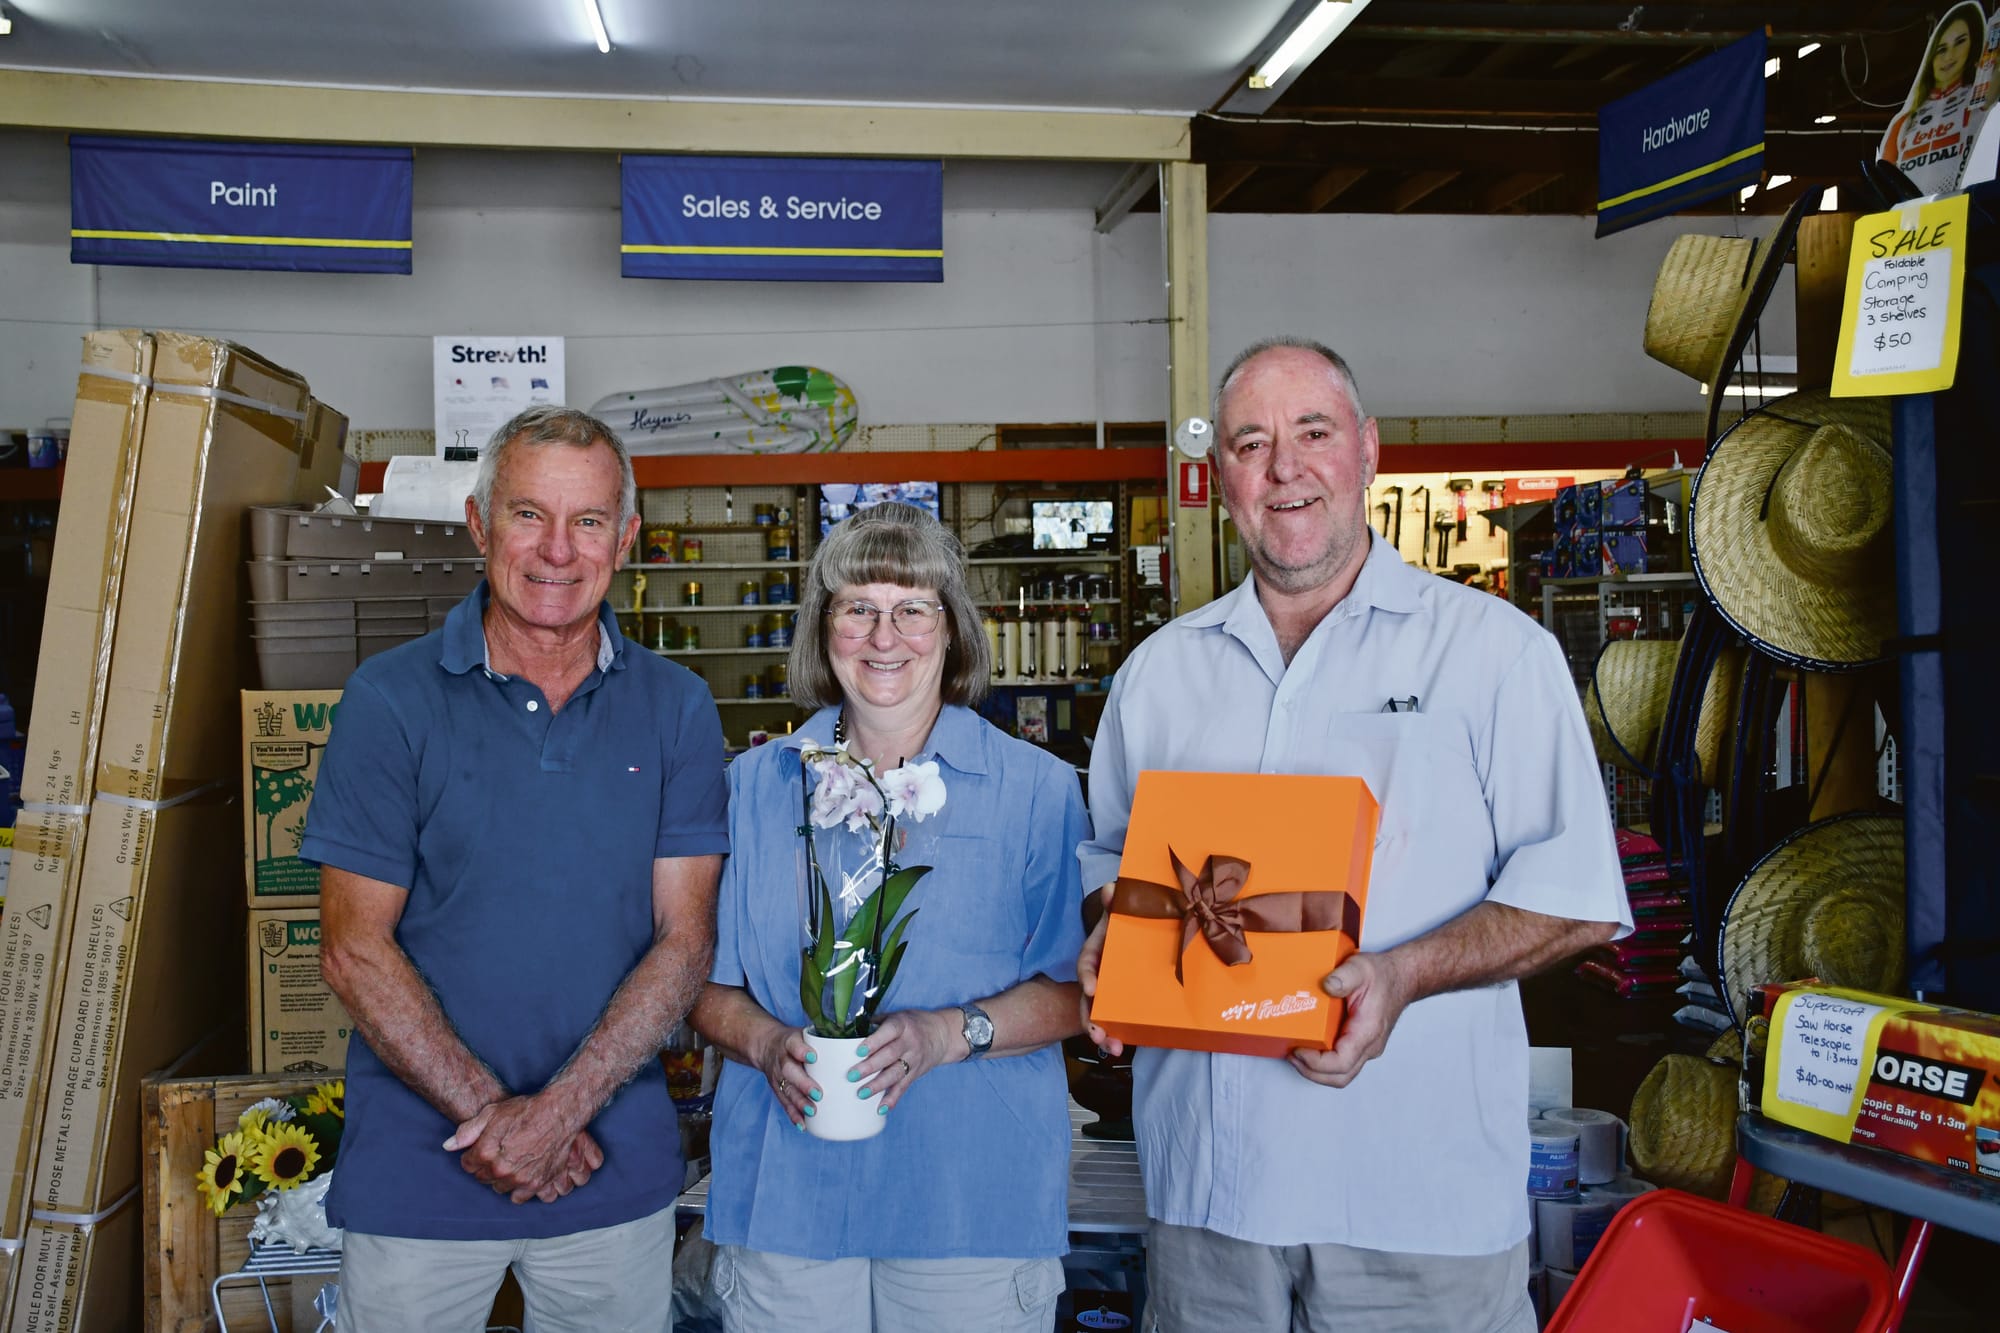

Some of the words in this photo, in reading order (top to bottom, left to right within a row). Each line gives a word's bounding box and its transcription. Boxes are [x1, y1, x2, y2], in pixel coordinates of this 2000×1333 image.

[1642, 107, 1711, 154] Hardware
[1900, 145, 1959, 173] SOUDAL
[210, 181, 278, 207] Paint
[682, 194, 750, 219] Sales
[759, 195, 779, 219] &
[786, 196, 882, 220] Service
[1869, 221, 1952, 259] SALE
[1884, 256, 1926, 270] Foldable
[1865, 271, 1929, 291] Camping
[1863, 294, 1916, 311] Storage
[1867, 314, 1876, 326] 3
[451, 345, 546, 363] Strewth!
[1873, 332, 1912, 351] $50
[70, 710, 81, 726] LH
[151, 704, 163, 719] LH
[48, 749, 61, 770] Kgs
[131, 743, 144, 764] Kgs
[46, 775, 57, 789] 24
[129, 769, 139, 782] 24
[141, 768, 155, 800] 22kgs
[40, 792, 54, 837] Weit:
[122, 787, 137, 829] Weit:
[48, 854, 60, 873] Net
[59, 774, 73, 805] 22kgs
[136, 810, 149, 843] weigh
[34, 840, 48, 872] Gross
[116, 832, 130, 864] Gross
[130, 847, 143, 866] Net
[110, 984, 122, 1013] 380W
[117, 945, 128, 972] 450D
[1795, 995, 1865, 1016] Supercraft
[13, 1033, 33, 1099] Size-1850H
[26, 992, 39, 1022] 380W
[33, 953, 45, 980] 450D
[71, 1000, 90, 1064] CUPBOARD
[1795, 1015, 1818, 1030] Saw
[1823, 1019, 1853, 1034] Horse
[1799, 1033, 1851, 1052] Telescopic
[1811, 1048, 1820, 1058] to
[1871, 1054, 1969, 1098] ORSE
[61, 1066, 79, 1121] STORAGE
[1868, 1109, 1880, 1119] for
[1881, 1112, 1918, 1130] durability
[1896, 1103, 1917, 1118] Bar
[1920, 1110, 1932, 1122] to
[1937, 1114, 1966, 1131] 1.3m
[54, 1124, 70, 1162] METAL
[32, 1264, 48, 1299] DOOR
[49, 1233, 69, 1317] Self-Assembly
[65, 1258, 79, 1286] GREY
